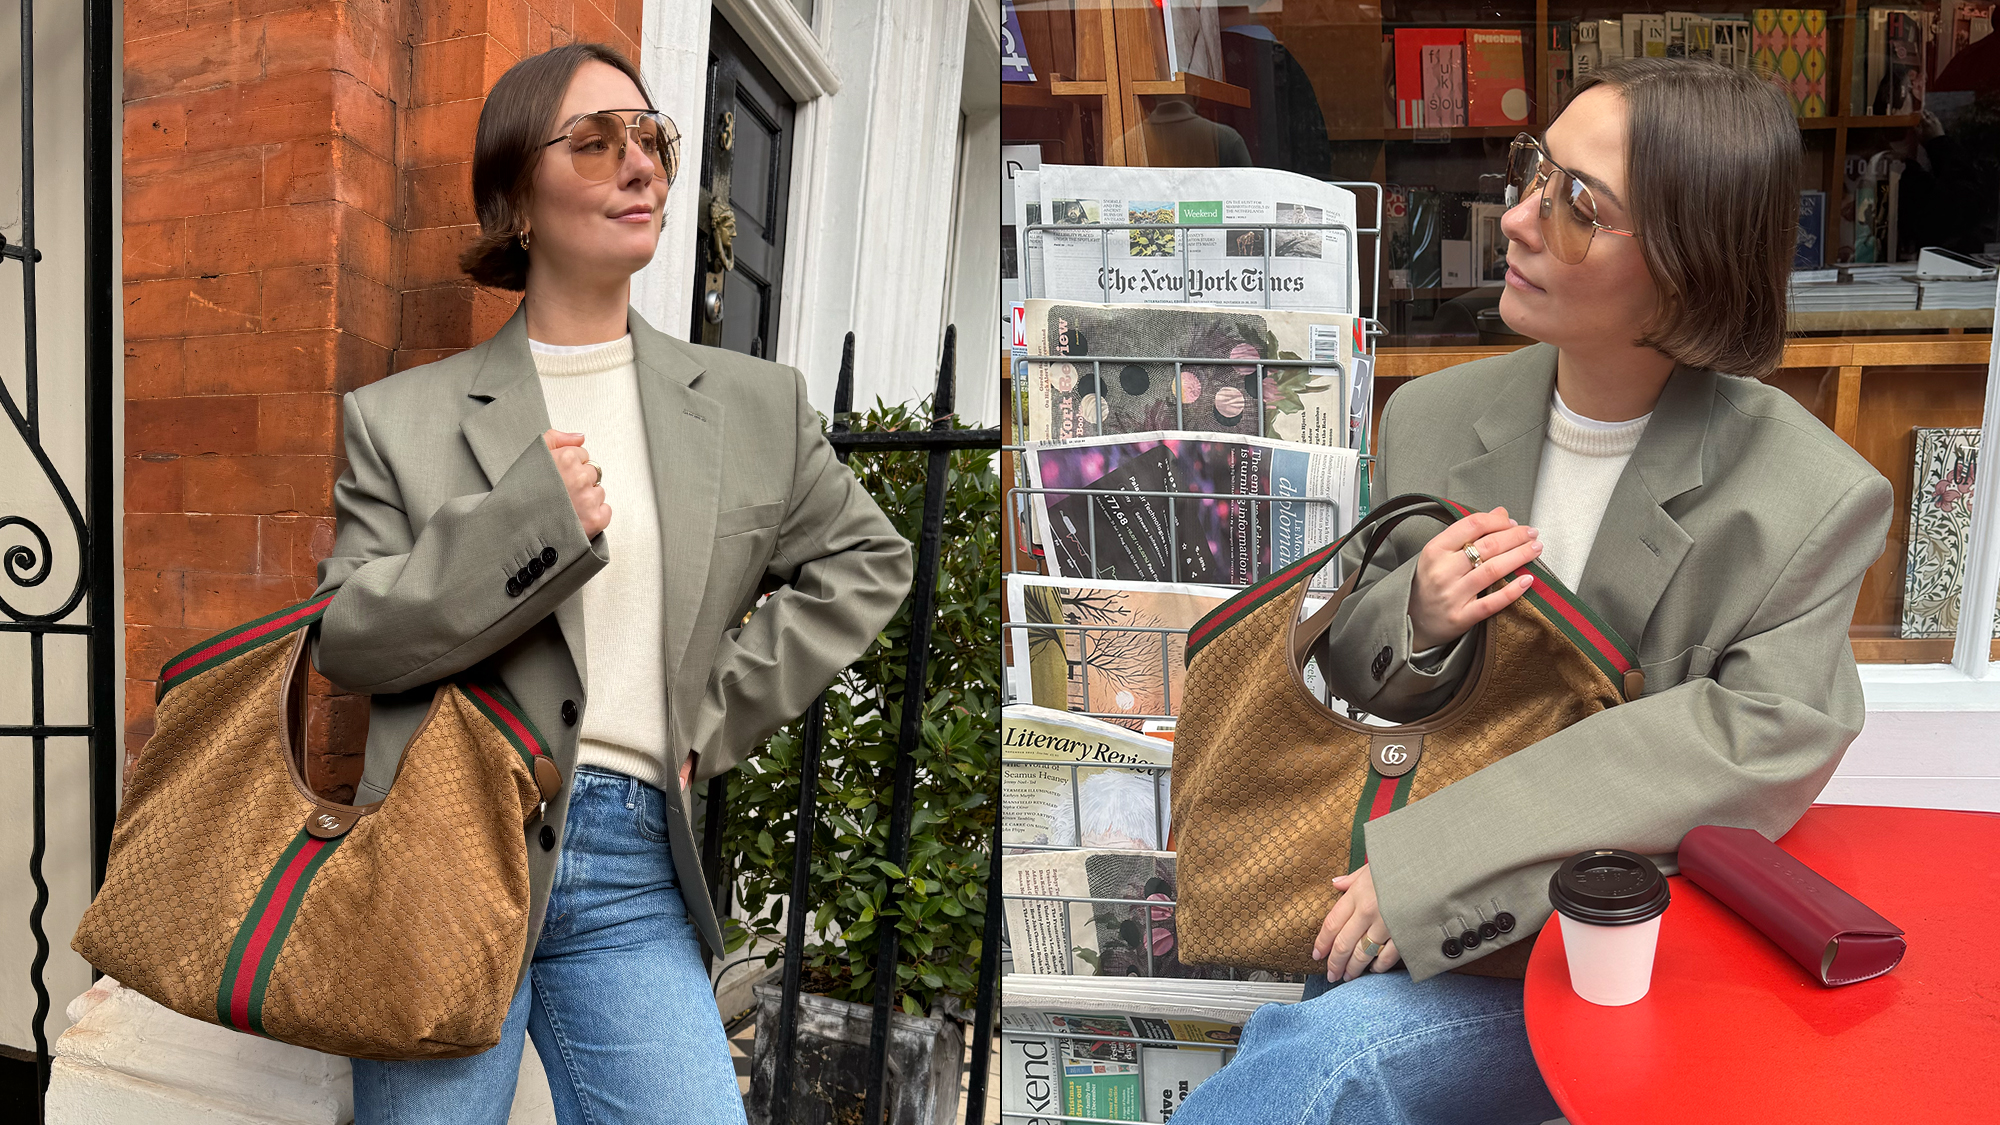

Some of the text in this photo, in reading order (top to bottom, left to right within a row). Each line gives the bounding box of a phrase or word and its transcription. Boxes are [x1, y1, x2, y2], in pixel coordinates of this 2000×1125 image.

[722, 111, 734, 151] 3
[1183, 208, 1218, 218] Weekend
[1098, 267, 1304, 298] The New York Times
[1056, 317, 1073, 439] York Reiew
[1240, 448, 1249, 458] is
[1251, 449, 1262, 472] The
[1128, 475, 1147, 503] Palair
[1142, 501, 1169, 543] Technologies
[1134, 511, 1148, 533] Software
[1238, 507, 1249, 575] information
[1294, 535, 1303, 560] MON
[1003, 727, 1093, 761] Literary
[1004, 770, 1069, 785] Seamus Heaney
[1058, 1029, 1070, 1056] 7Das
[1075, 1100, 1083, 1117] days
